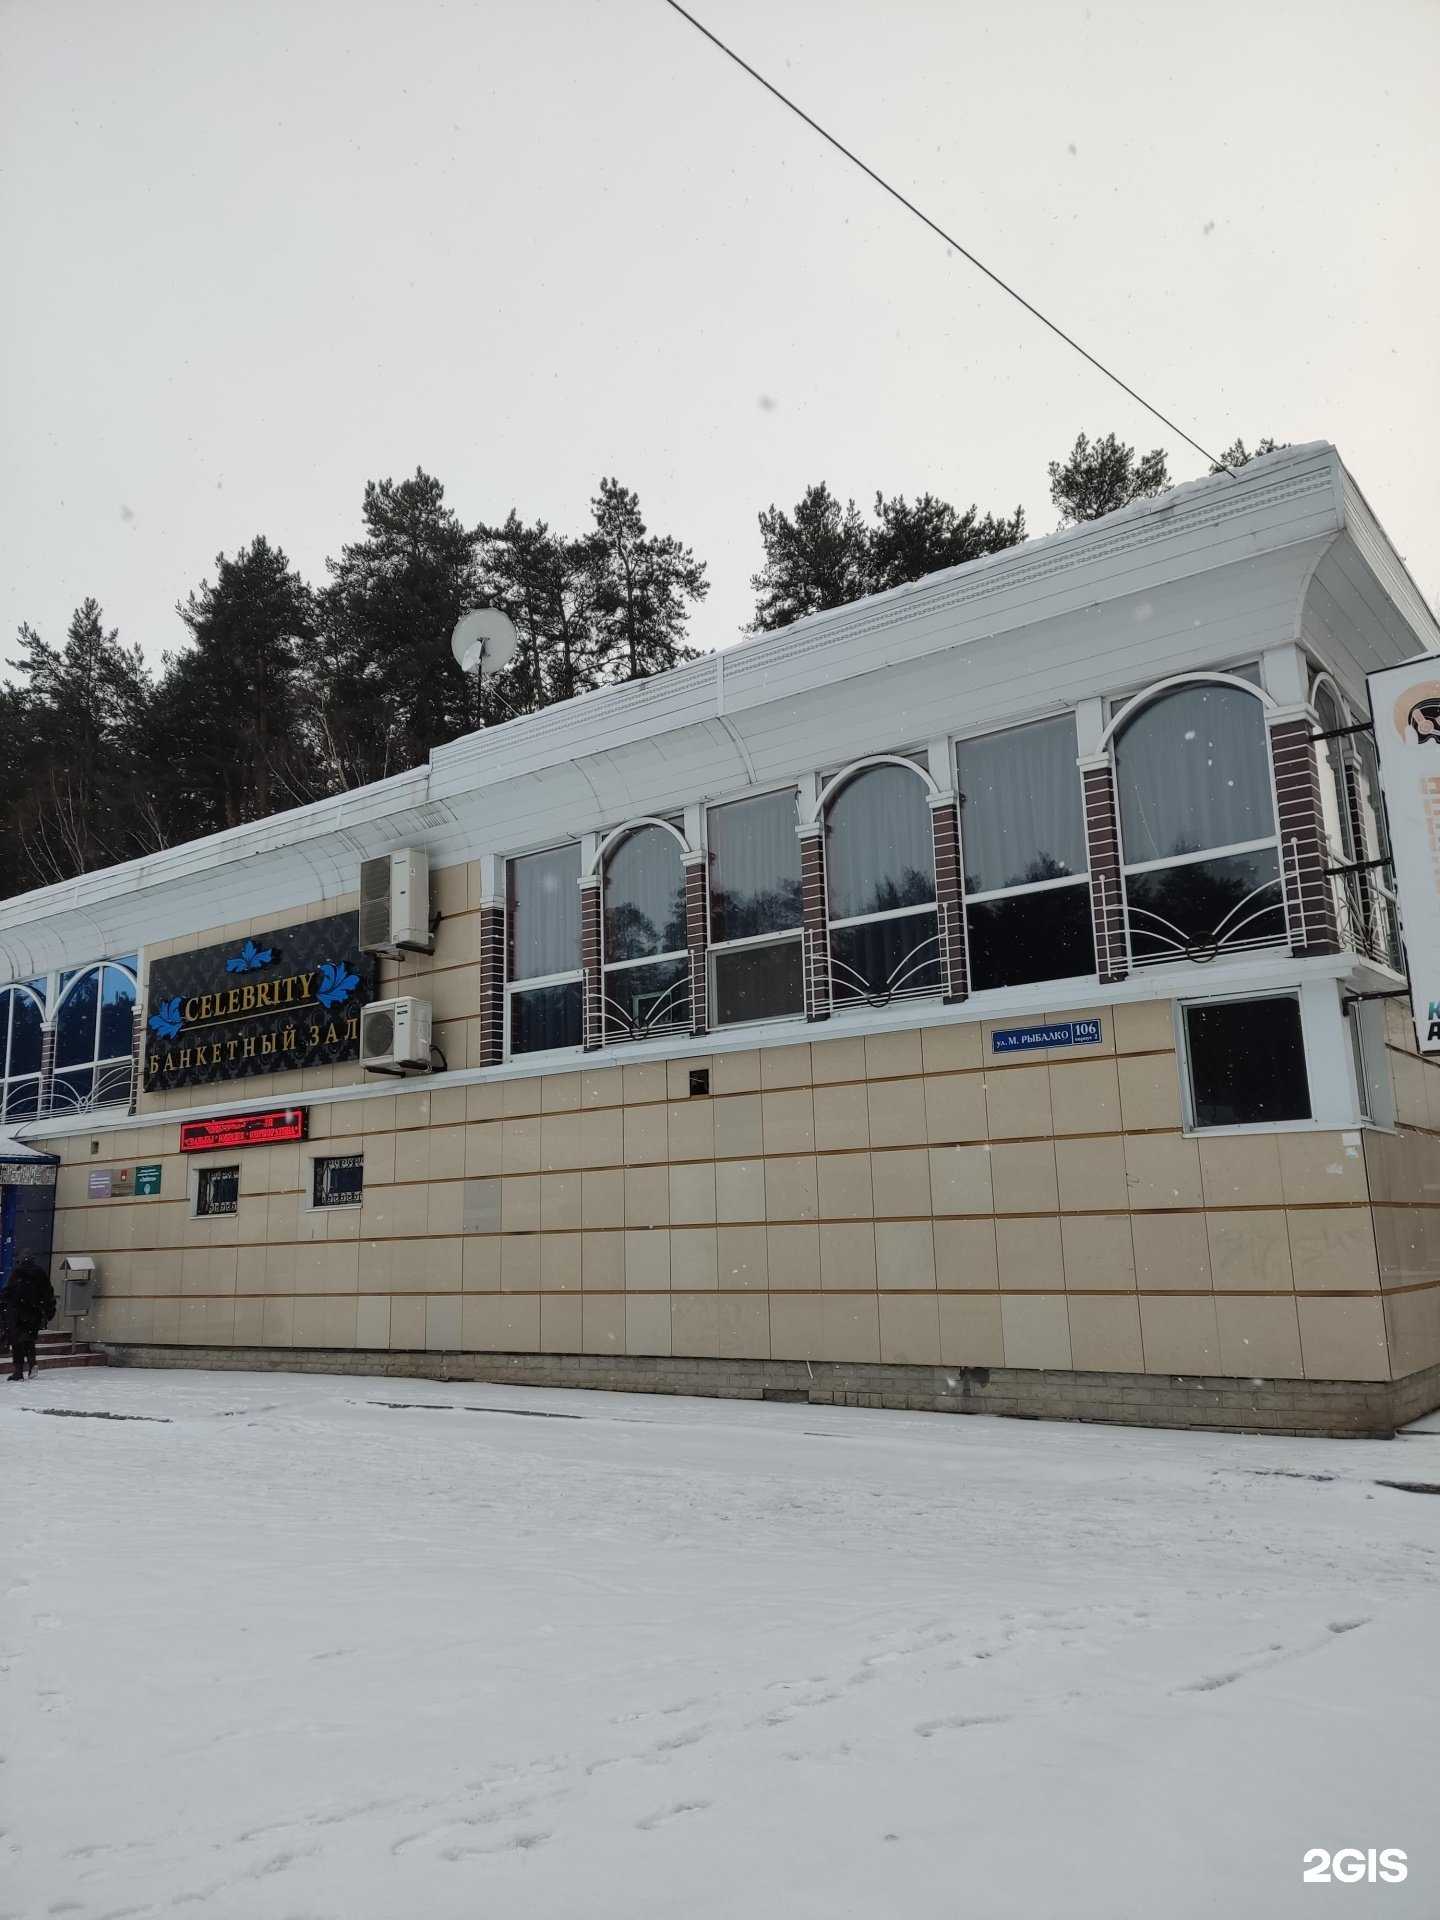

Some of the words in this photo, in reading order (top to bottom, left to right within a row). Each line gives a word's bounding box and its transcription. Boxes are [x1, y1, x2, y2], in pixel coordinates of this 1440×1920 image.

[185, 972, 315, 1022] CELEBRITY
[1008, 1036, 1019, 1045] М.
[1021, 1030, 1069, 1044] РЫБАЛКО
[1074, 1022, 1096, 1036] 106
[150, 1025, 297, 1074] БАНКЕТНЫЙ
[309, 1017, 358, 1047] ЗАЛ
